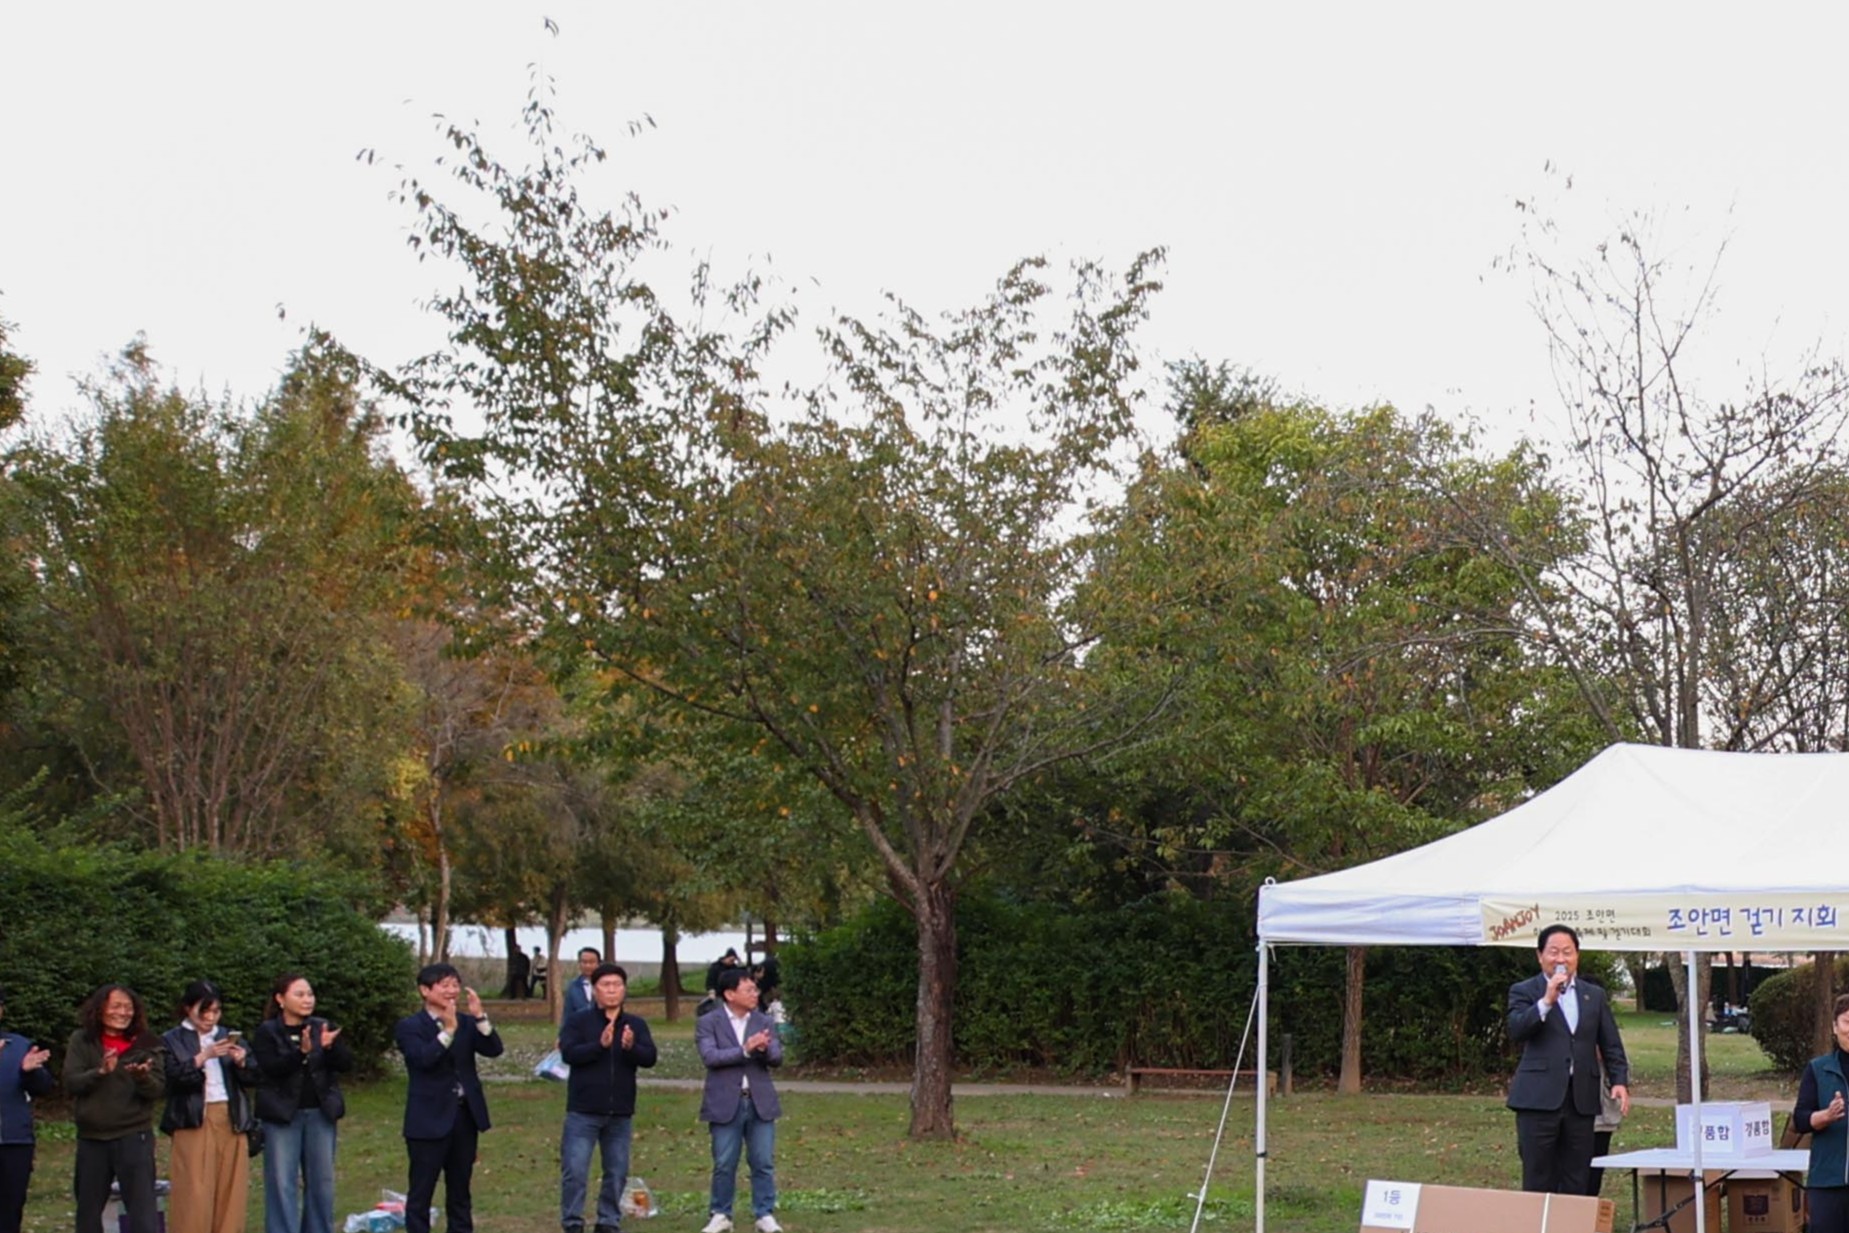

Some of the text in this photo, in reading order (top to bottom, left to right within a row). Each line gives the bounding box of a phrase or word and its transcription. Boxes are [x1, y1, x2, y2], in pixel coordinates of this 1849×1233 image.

[1555, 909, 1616, 923] 2025 조안면
[1667, 904, 1837, 936] 조안면 걷기 지회
[1700, 1125, 1730, 1141] 품함
[1745, 1120, 1769, 1137] 경품함
